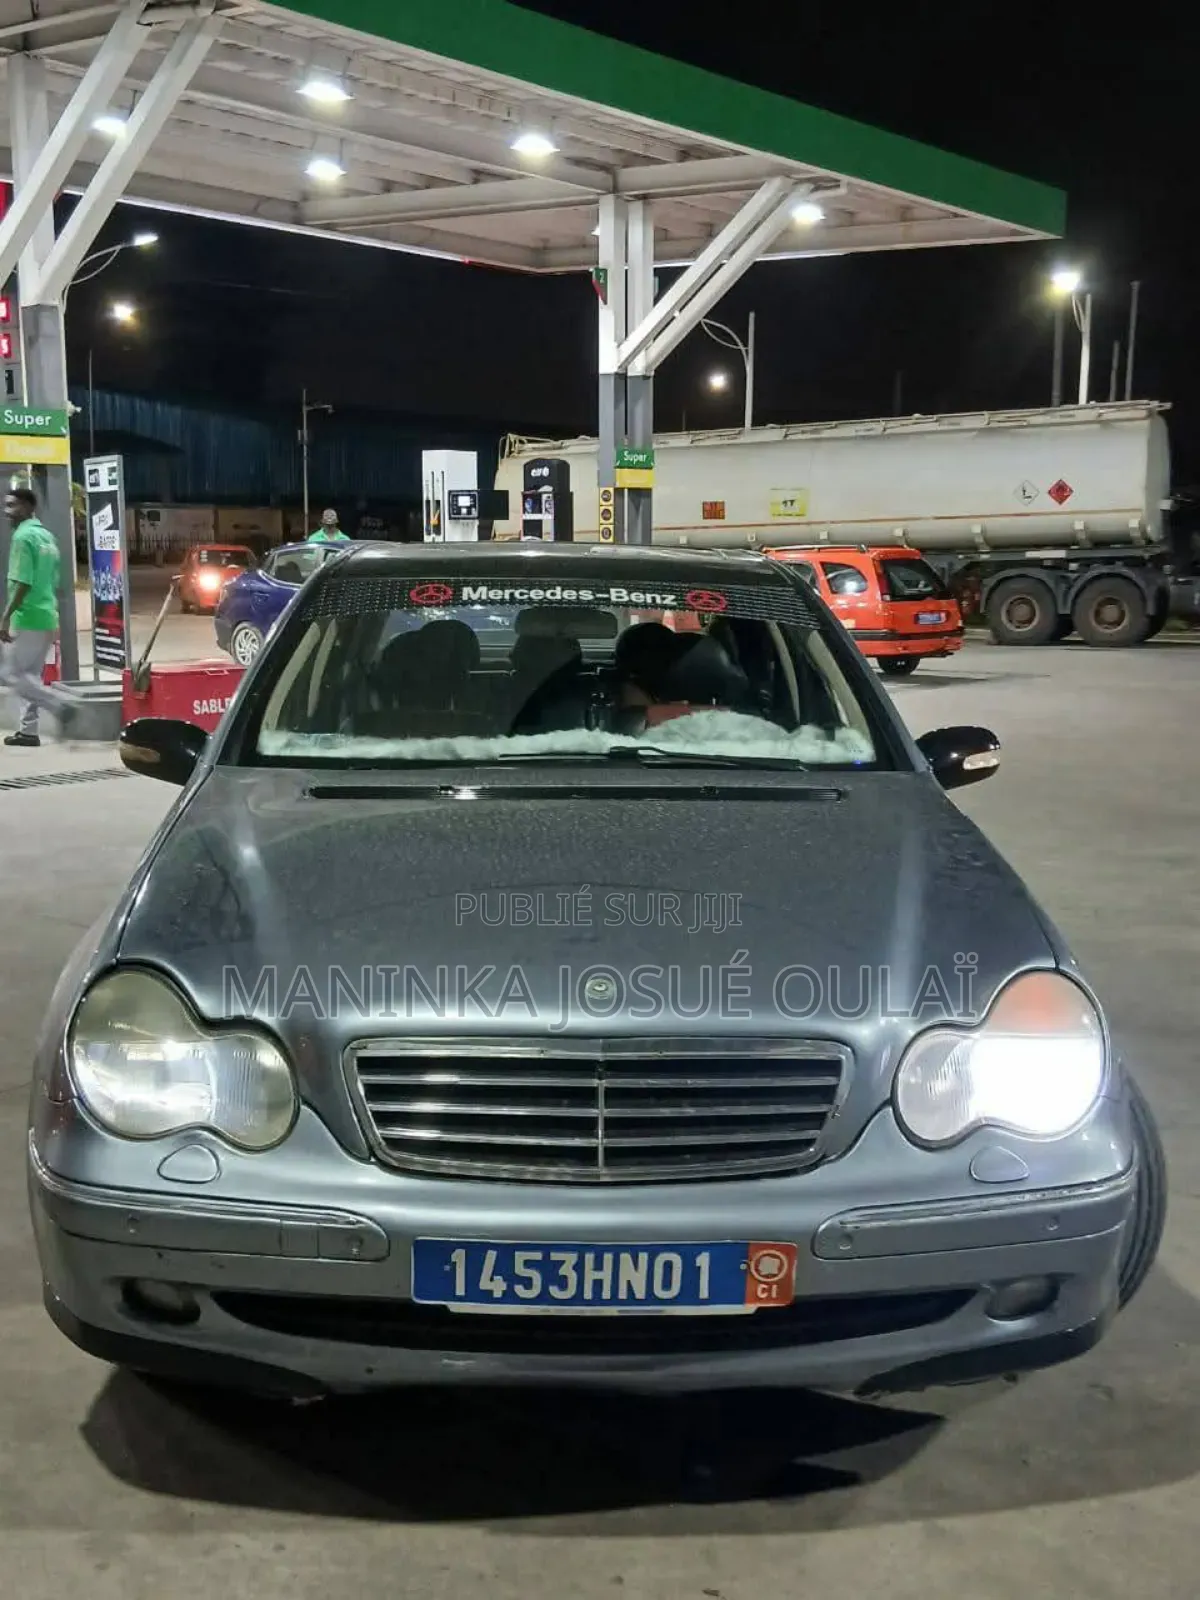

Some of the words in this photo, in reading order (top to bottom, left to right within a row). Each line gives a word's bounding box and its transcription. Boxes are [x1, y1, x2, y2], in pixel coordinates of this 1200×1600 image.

[4, 409, 52, 429] Super
[623, 450, 647, 465] Super
[461, 586, 678, 605] Mercedes-Benz
[451, 1249, 710, 1300] 1453HN01
[757, 1283, 777, 1298] CI
